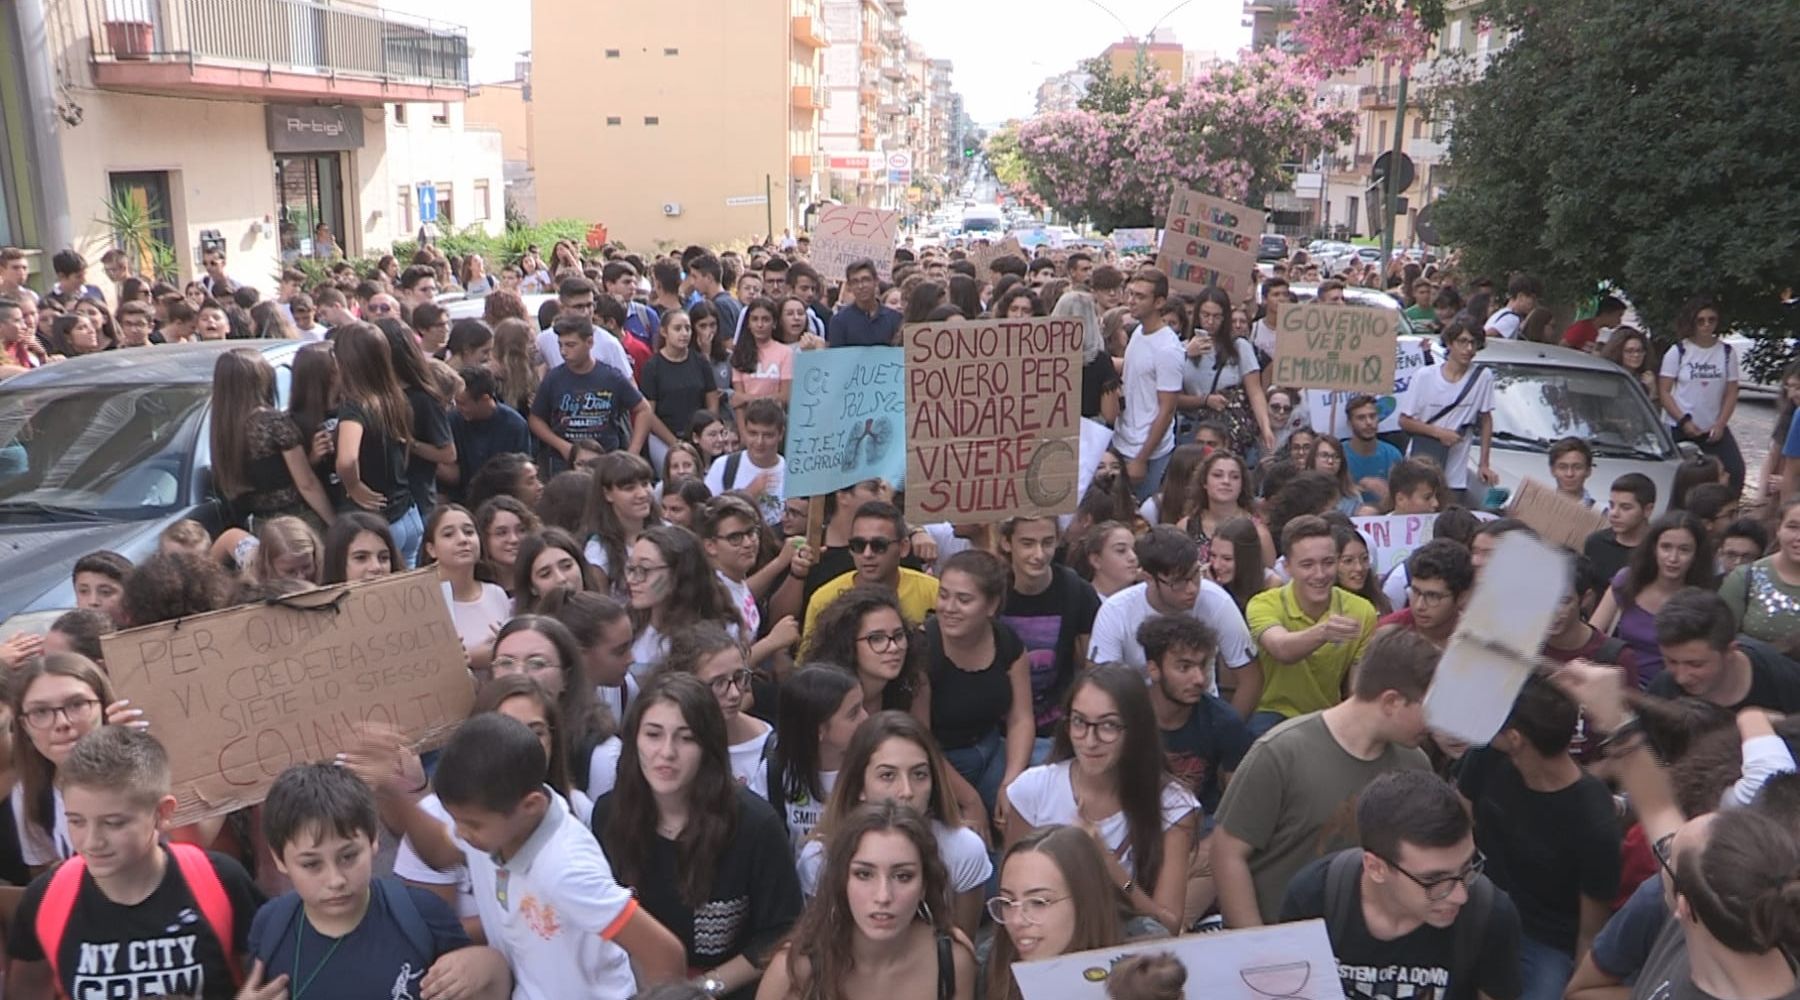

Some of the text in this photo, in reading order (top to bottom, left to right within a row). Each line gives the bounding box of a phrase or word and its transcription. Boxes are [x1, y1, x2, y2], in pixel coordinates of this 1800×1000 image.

[821, 206, 895, 239] SEX
[1283, 307, 1389, 337] GOVERNO
[912, 321, 1084, 363] SONO TROPPO
[1306, 332, 1362, 350] VERO
[750, 362, 780, 378] LA
[911, 357, 1072, 403] POVERO PER
[911, 391, 1070, 439] ANDARE A
[916, 433, 1035, 480] VIVERE
[920, 478, 1019, 513] SULLA
[138, 629, 224, 684] PER
[400, 583, 438, 616] VOI
[170, 684, 211, 719] VI
[219, 657, 441, 739] SIETE LO STESSO
[77, 934, 197, 974] NY CITY
[1410, 967, 1449, 986] DOWN
